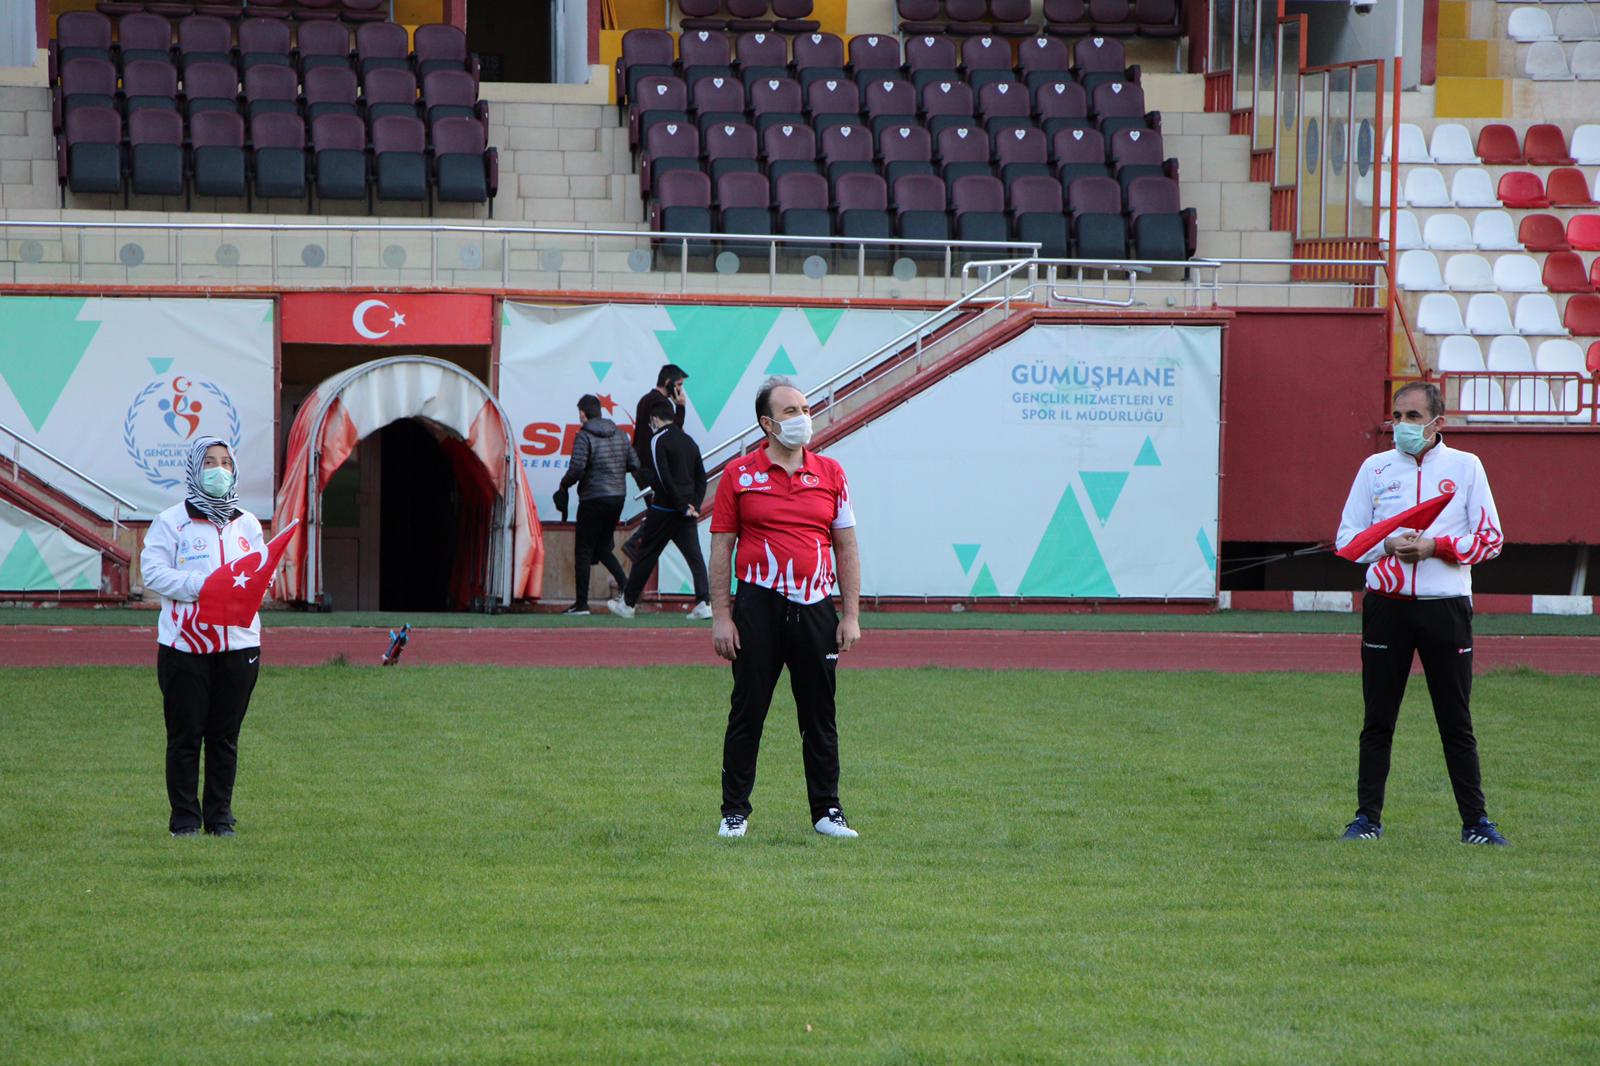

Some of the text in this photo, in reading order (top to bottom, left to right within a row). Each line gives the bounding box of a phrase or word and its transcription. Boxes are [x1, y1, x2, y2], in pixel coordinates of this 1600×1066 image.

[1011, 360, 1176, 391] GÜMÜŞHANE
[1159, 395, 1174, 406] VE
[1022, 408, 1056, 420] SPOR
[1076, 407, 1163, 422] MÜDÜRLÜĞÜ
